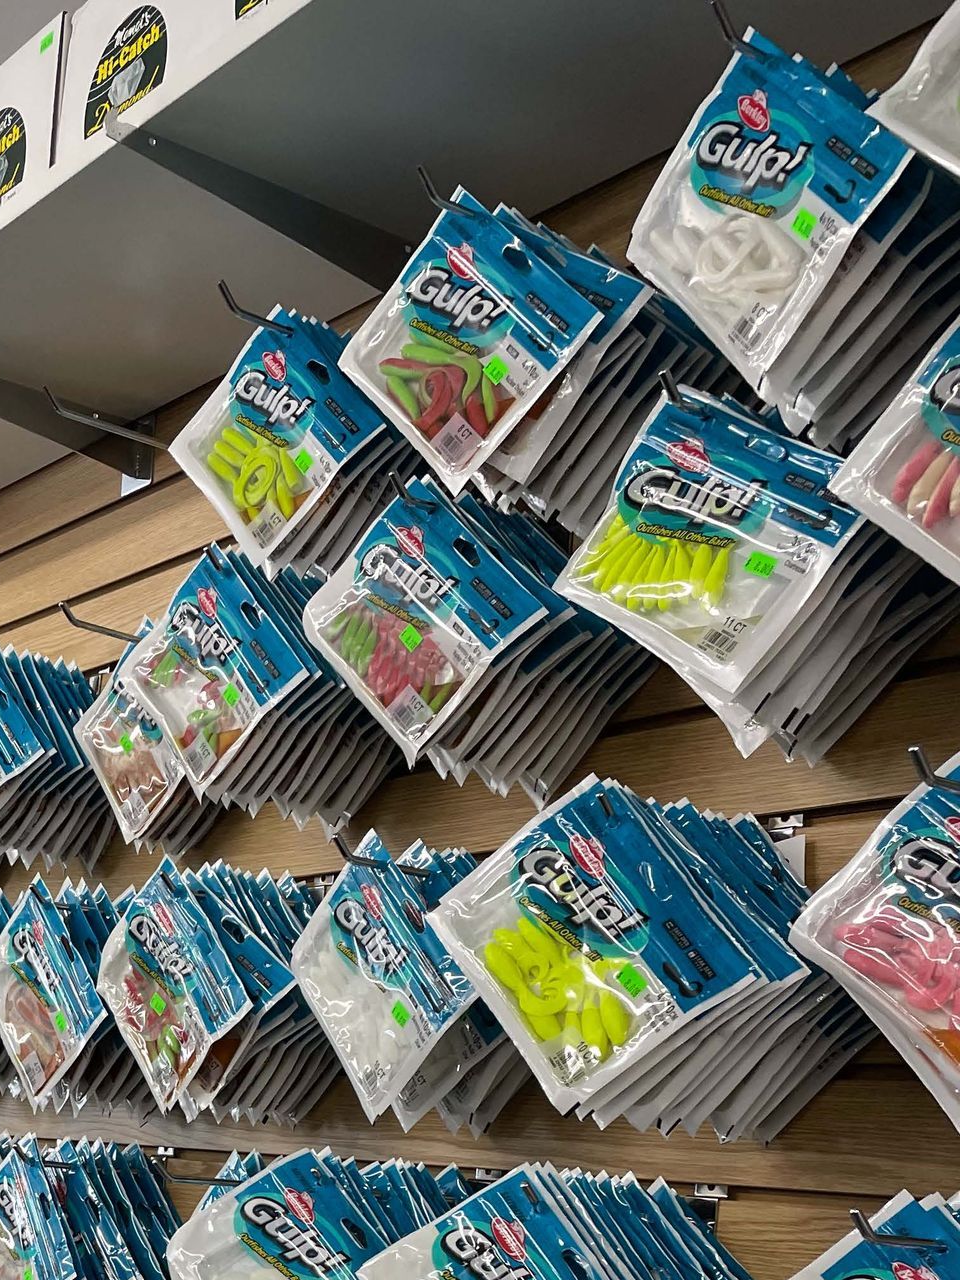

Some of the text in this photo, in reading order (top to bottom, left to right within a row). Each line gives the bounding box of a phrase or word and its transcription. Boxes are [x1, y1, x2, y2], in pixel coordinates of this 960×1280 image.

[96, 24, 161, 85] Hi-Catch
[698, 123, 809, 193] Gulp!
[410, 266, 508, 330] Gulp!
[235, 372, 312, 425] Gulp!
[636, 522, 732, 548] Outfishes All Other Bait!
[724, 616, 747, 634] 11 CT
[239, 1233, 267, 1260] Outfishes
[265, 1255, 276, 1268] All
[273, 1261, 291, 1279] Other
[242, 1197, 349, 1276] Gulp!
